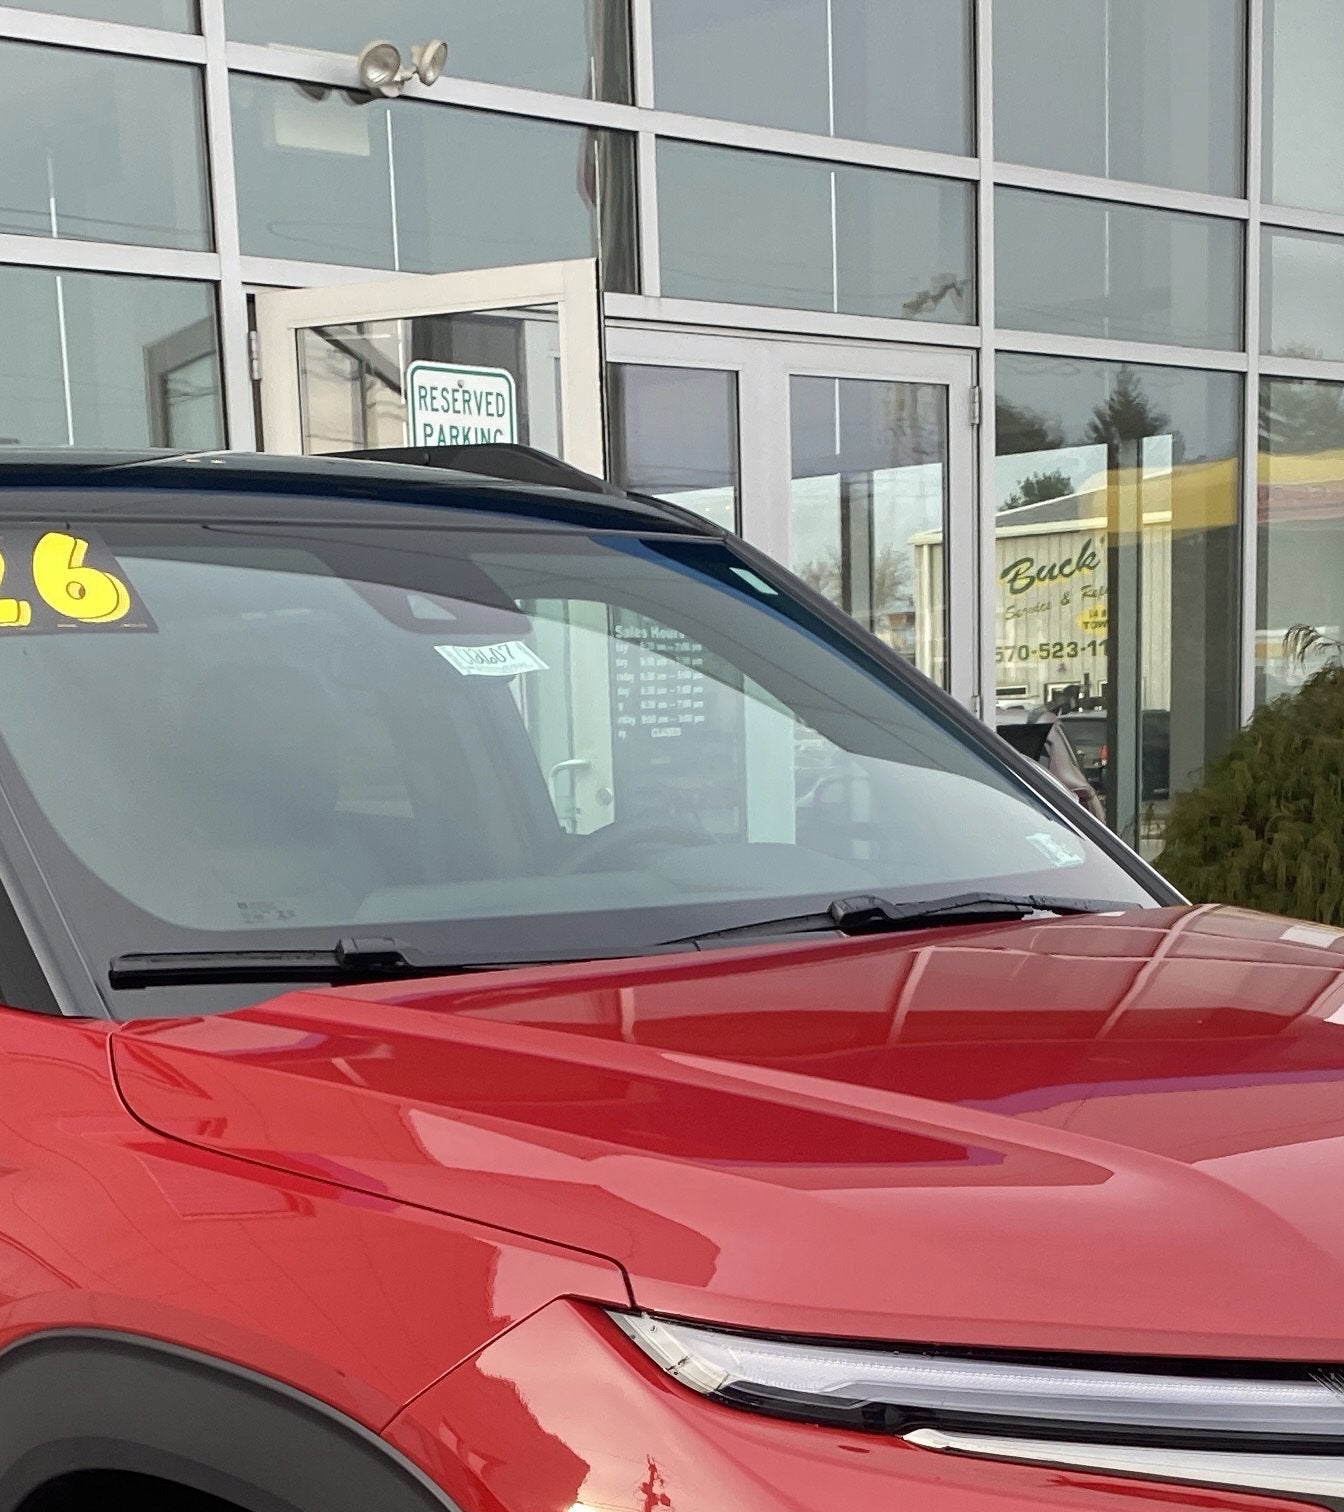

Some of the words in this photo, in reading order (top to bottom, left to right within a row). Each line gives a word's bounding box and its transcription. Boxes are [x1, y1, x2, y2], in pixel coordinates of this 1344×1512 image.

[418, 385, 506, 418] RESERVED
[1000, 538, 1106, 595] Buck'
[616, 625, 647, 639] Sales
[996, 640, 1108, 662] 570-523-11
